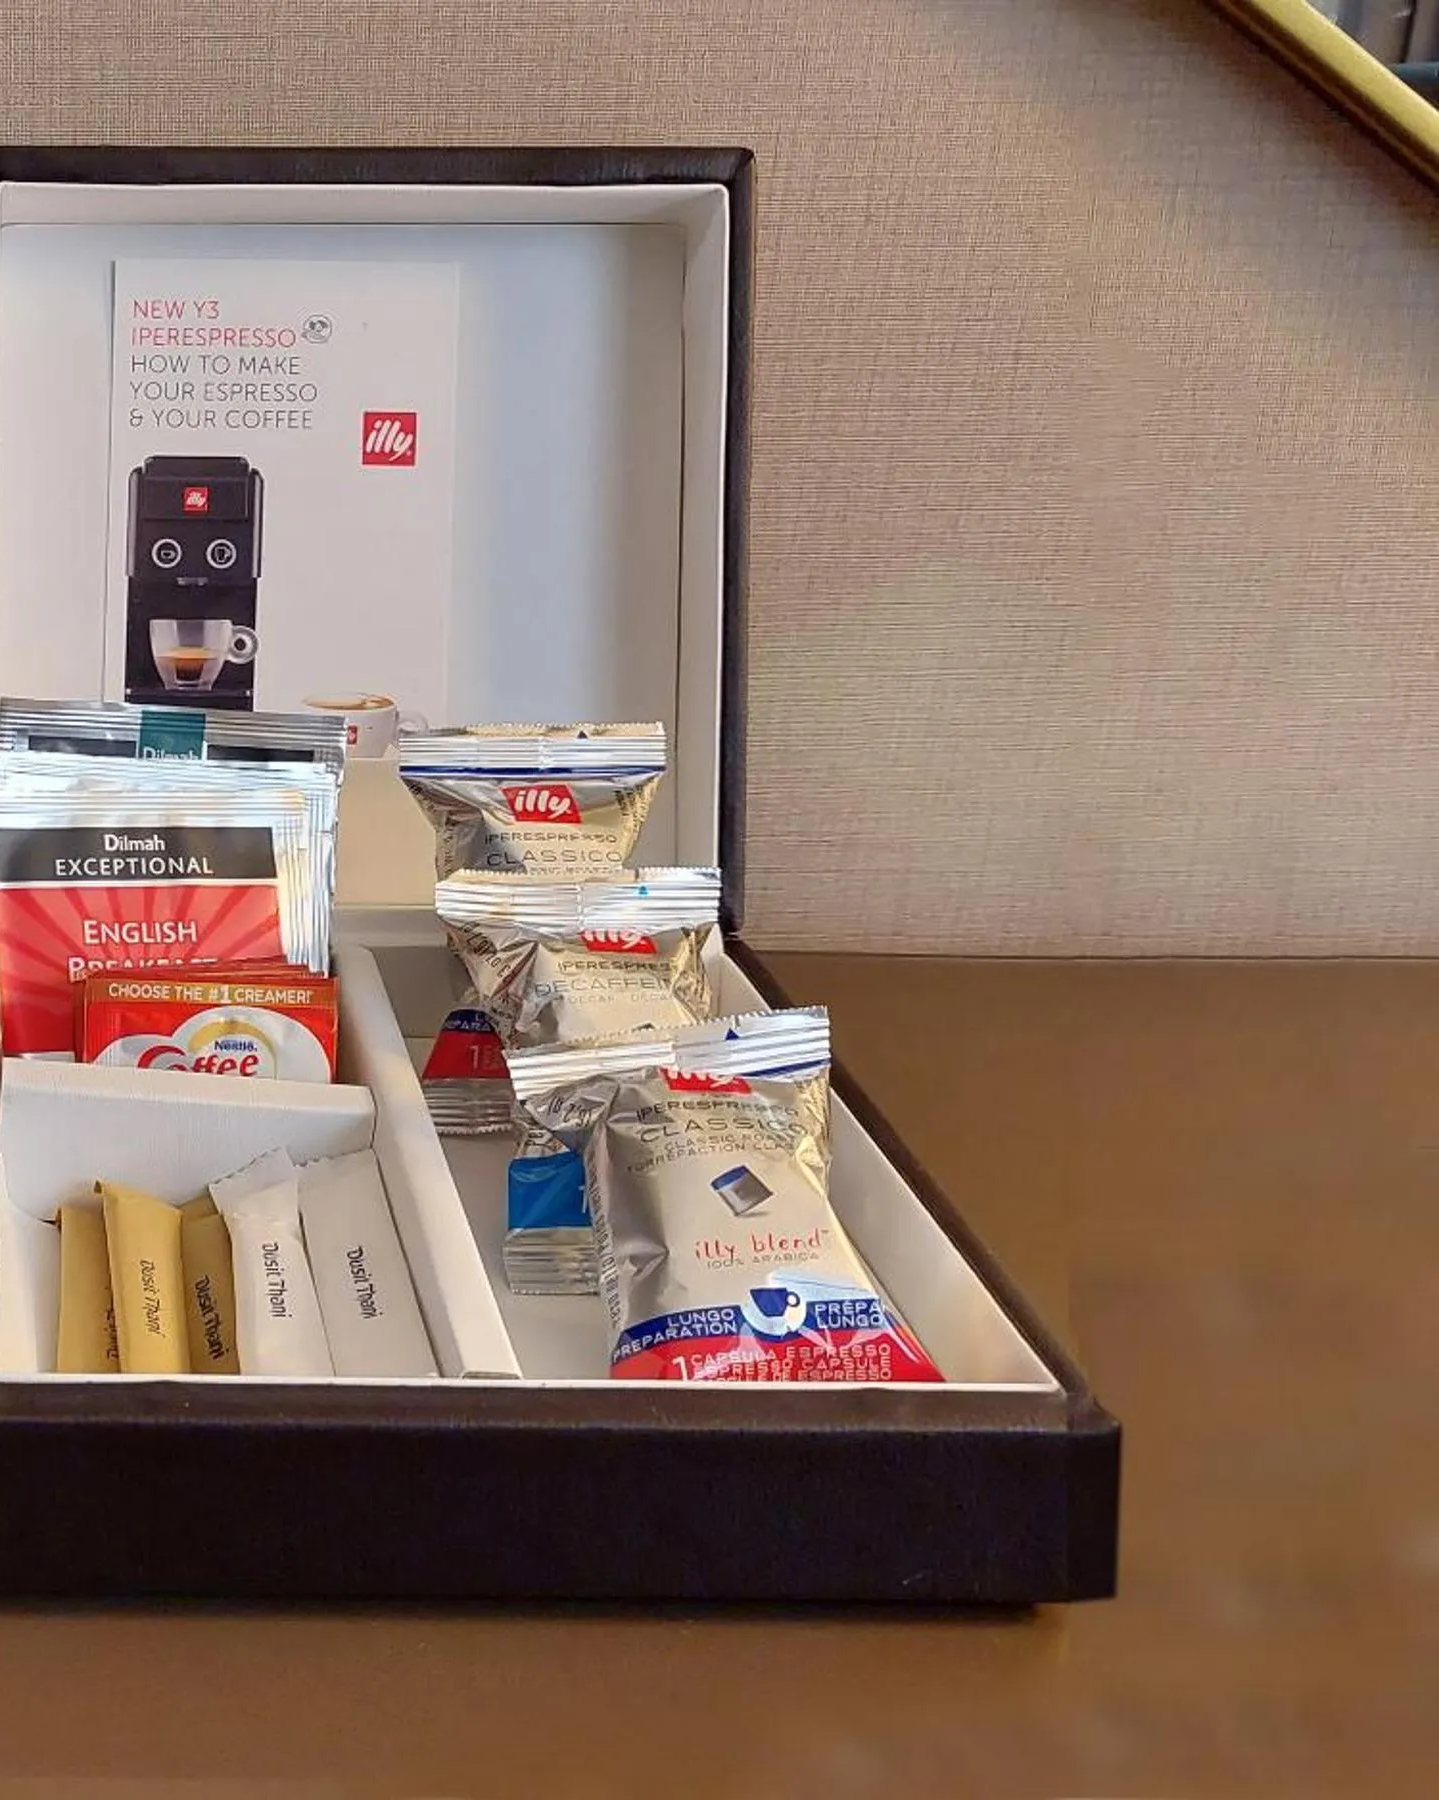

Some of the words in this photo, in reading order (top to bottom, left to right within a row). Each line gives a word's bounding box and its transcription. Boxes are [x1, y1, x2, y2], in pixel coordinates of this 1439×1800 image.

[132, 300, 185, 319] NEW
[194, 300, 220, 319] Y3
[132, 327, 297, 348] IPERESPRESSO
[131, 354, 191, 375] HOW
[199, 355, 231, 375] TO
[238, 356, 301, 375] MAKE
[129, 381, 195, 401] YOUR
[203, 383, 318, 402] ESPRESSO
[129, 410, 143, 428] &
[151, 409, 217, 429] YOUR
[225, 410, 313, 430] COFFEE
[365, 419, 414, 461] illy
[514, 789, 572, 819] illy
[104, 834, 166, 852] Dilmah
[55, 857, 214, 876] EXCEPTIONAL
[487, 849, 621, 866] CLASSICO
[83, 920, 197, 945] ENGLISH
[109, 982, 170, 999] CHOOSE
[175, 984, 203, 1001] THE
[209, 984, 232, 1003] #1
[640, 1117, 808, 1143] CLASSICO
[694, 1239, 736, 1262] illy
[751, 1228, 821, 1252] blend
[262, 1242, 281, 1278] Dusit
[347, 1245, 370, 1285] Dusit
[269, 1279, 294, 1319] Thani
[356, 1281, 385, 1319] Thani
[666, 1308, 736, 1327] LUNGO
[817, 1314, 883, 1329] LUNGO
[613, 1321, 738, 1363] PREPARATION
[786, 1343, 891, 1358] ESPRESSO
[671, 1356, 688, 1381] 1
[802, 1356, 891, 1370] CAPSULE
[798, 1368, 892, 1381] ESPRESSO
